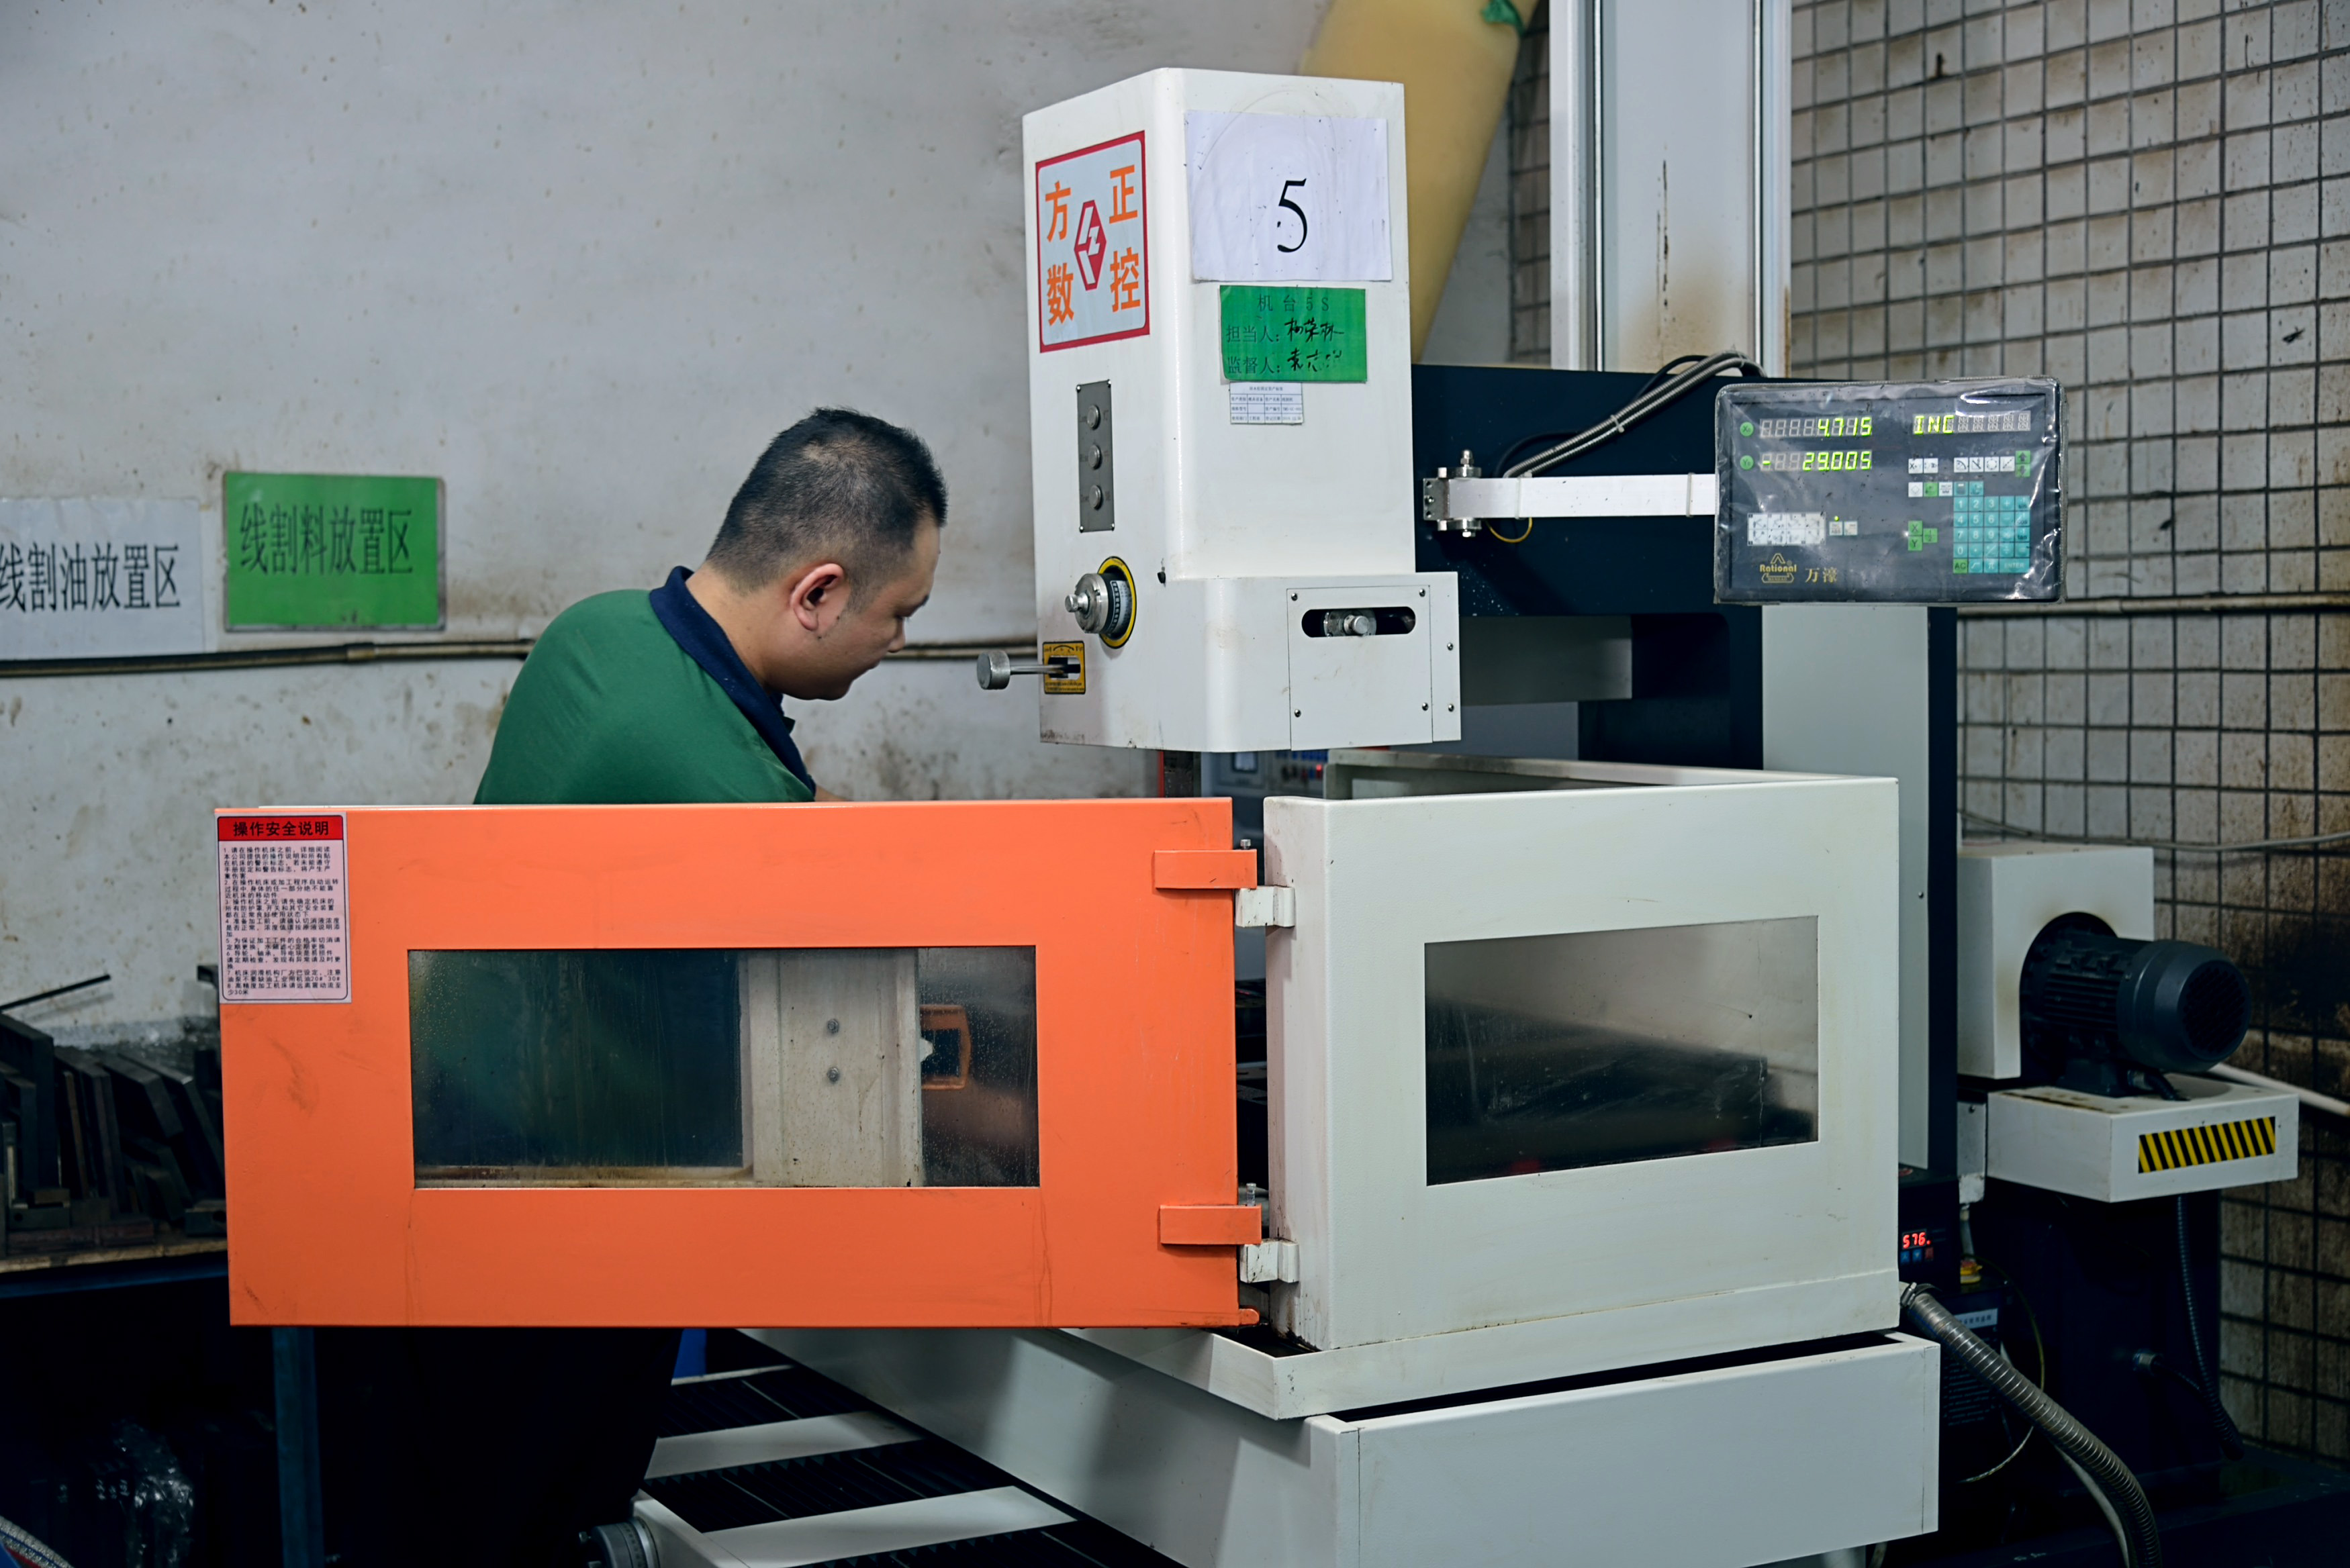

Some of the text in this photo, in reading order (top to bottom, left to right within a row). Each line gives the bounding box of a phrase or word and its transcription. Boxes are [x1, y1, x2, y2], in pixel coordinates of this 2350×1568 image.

[1277, 178, 1308, 253] 5
[1817, 417, 1872, 438] 4.715
[1914, 414, 1954, 435] INC
[1803, 450, 1872, 471] 29.005
[1958, 499, 1963, 508] 1
[1973, 499, 1979, 508] 2
[1988, 499, 1994, 507] 3
[1957, 516, 1963, 524] 4
[1973, 515, 1979, 524] 5
[1988, 515, 1994, 523] 6
[1957, 530, 1963, 538] 7
[1973, 530, 1979, 538] 8
[1988, 530, 1994, 538] 9
[239, 503, 413, 576] 线割料放置区
[1912, 540, 1918, 548] Y
[1957, 546, 1963, 554] 0
[1760, 563, 1797, 573] Rational
[1955, 562, 1966, 570] AC
[0, 542, 181, 612] 线割油放置区
[233, 821, 329, 836] 操作安全说明
